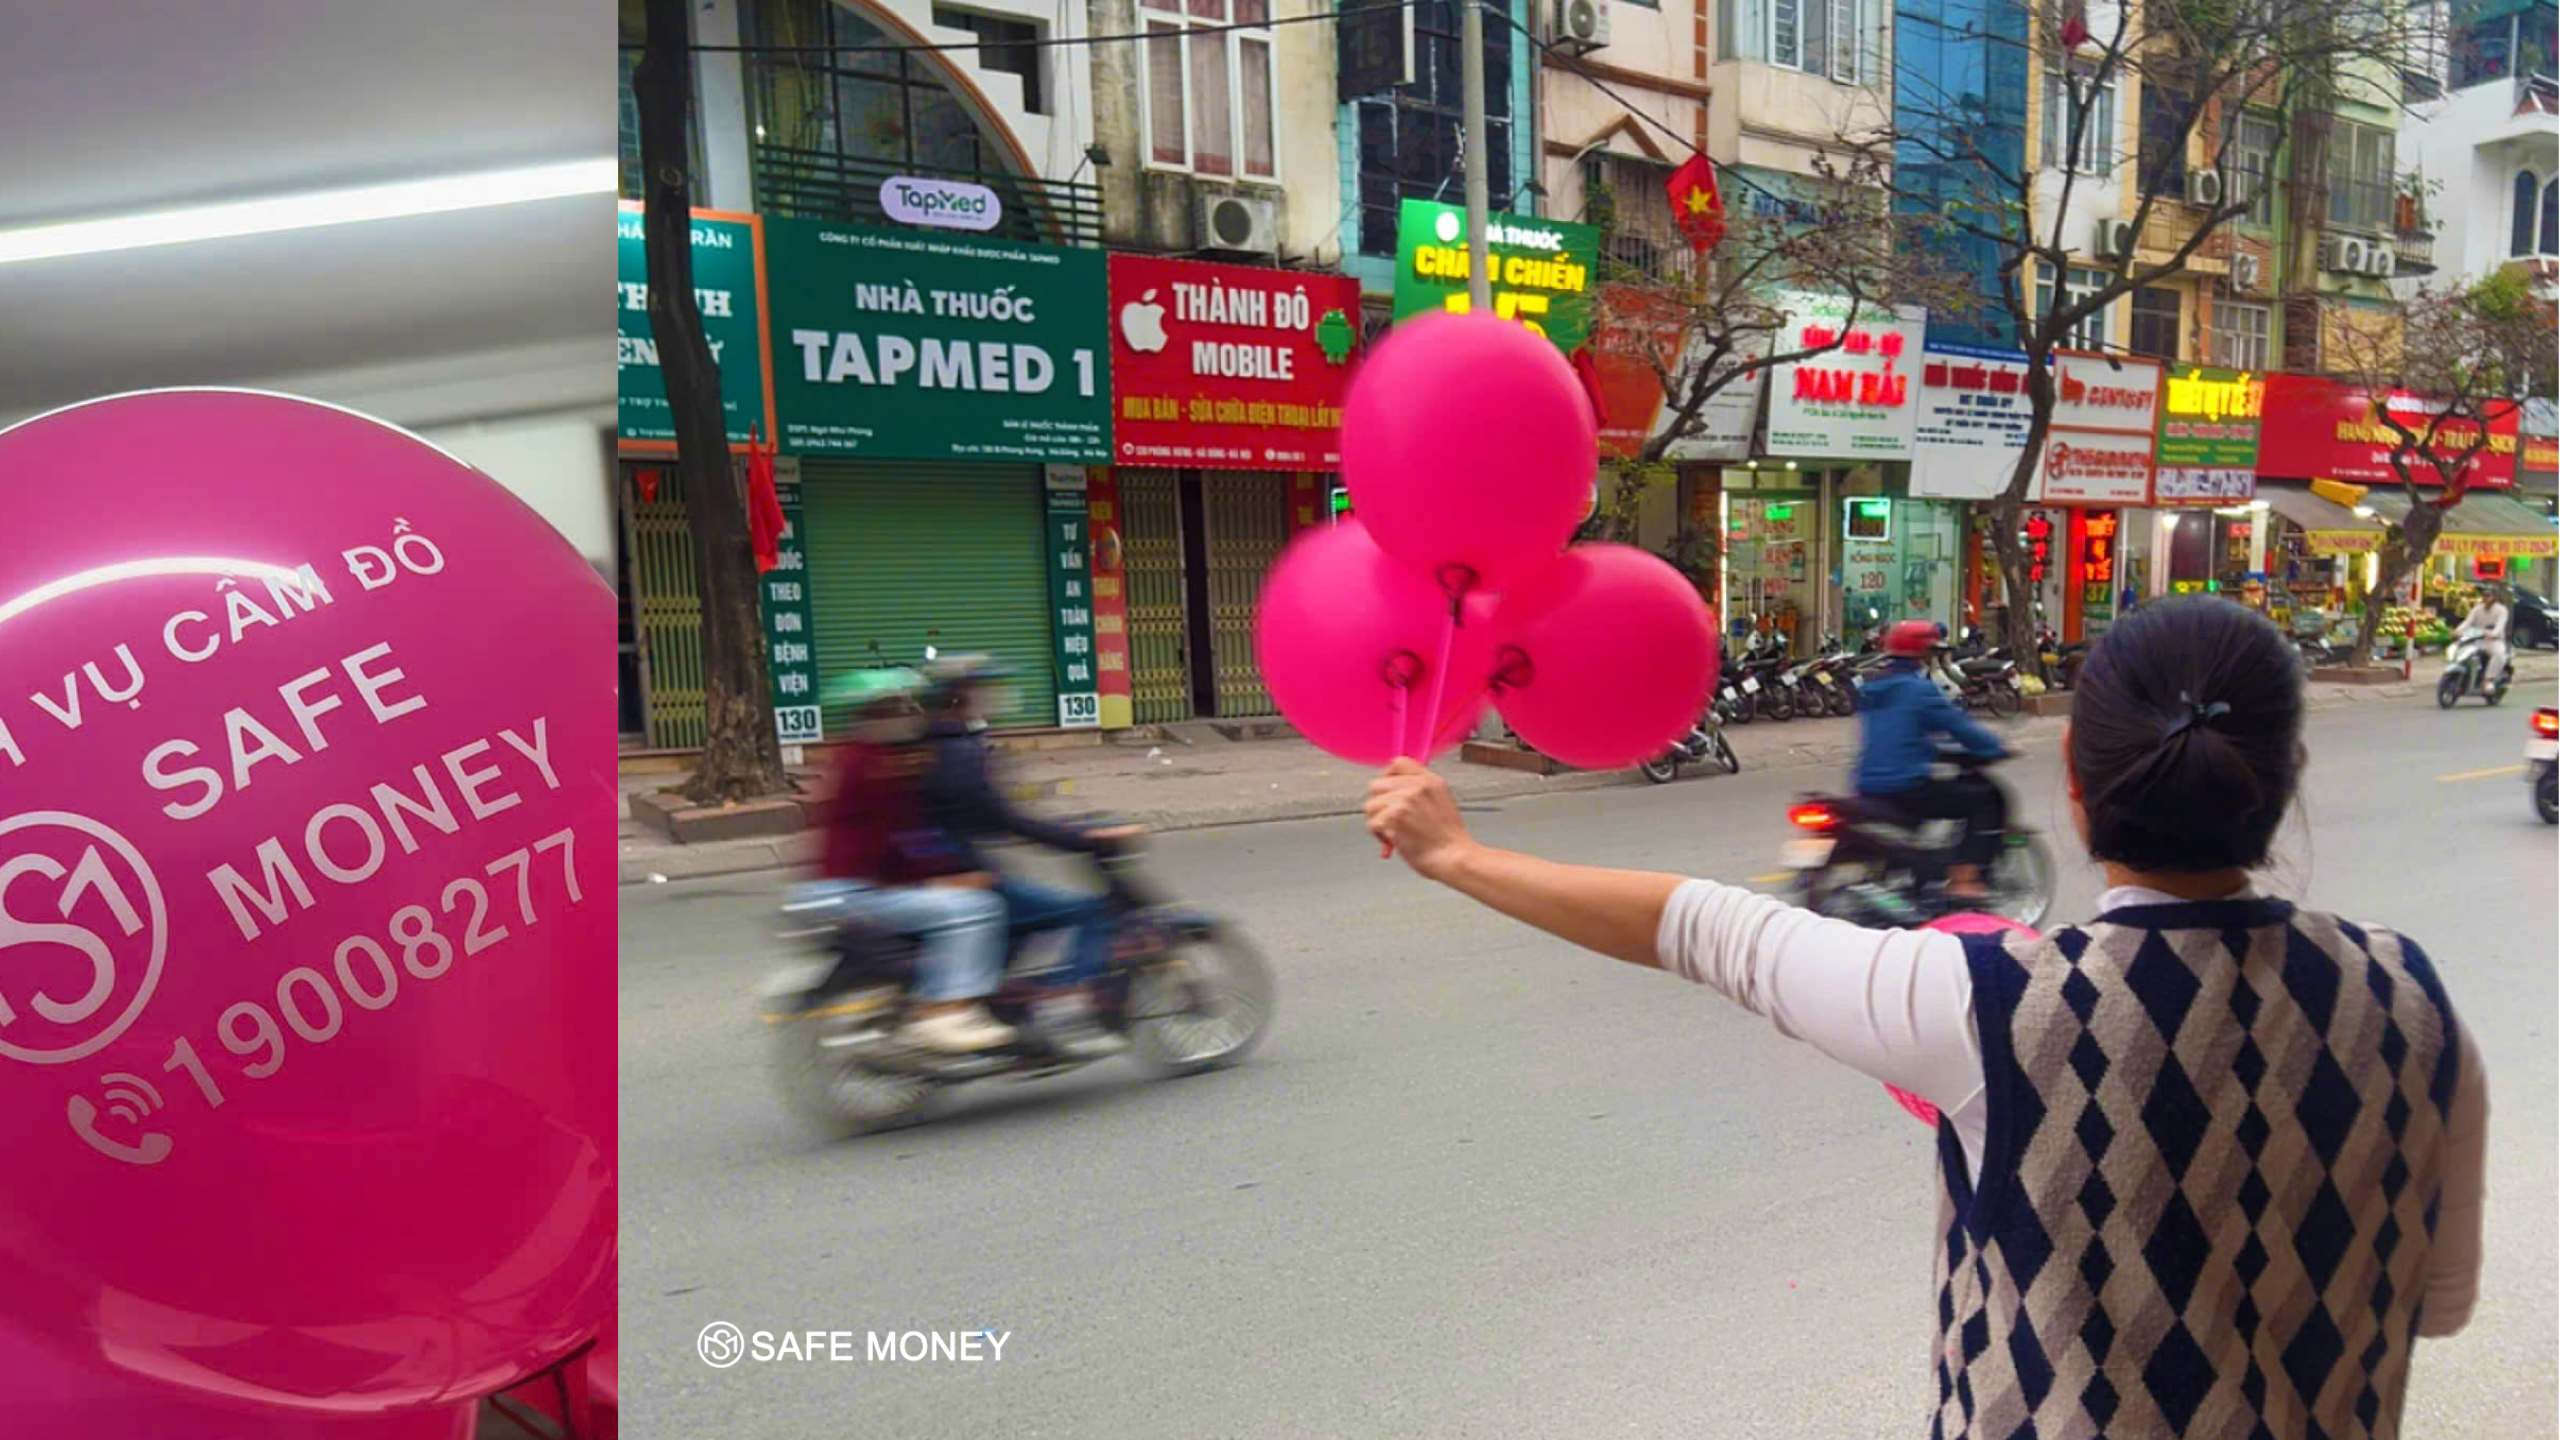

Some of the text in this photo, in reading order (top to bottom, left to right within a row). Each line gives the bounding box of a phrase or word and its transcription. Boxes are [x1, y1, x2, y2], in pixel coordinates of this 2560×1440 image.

[896, 184, 987, 216] TapMed
[1505, 253, 1586, 292] CHIẾN
[856, 278, 1036, 323] NHÀ THUỐC
[1172, 277, 1310, 331] THÀNH ĐÔ
[792, 328, 1055, 394] TAPMED
[1072, 348, 1095, 397] 1
[1192, 340, 1295, 381] MOBILE
[1153, 394, 1179, 421] BÁN
[769, 581, 802, 602] THEO
[1860, 571, 1886, 590] 120
[29, 643, 146, 730] VỤ
[341, 517, 445, 591] ĐỒ
[778, 709, 817, 732] 130
[1066, 696, 1096, 716] 130
[141, 640, 429, 822] SAFE
[205, 716, 563, 943] MONEY
[162, 827, 585, 1110] 19008277
